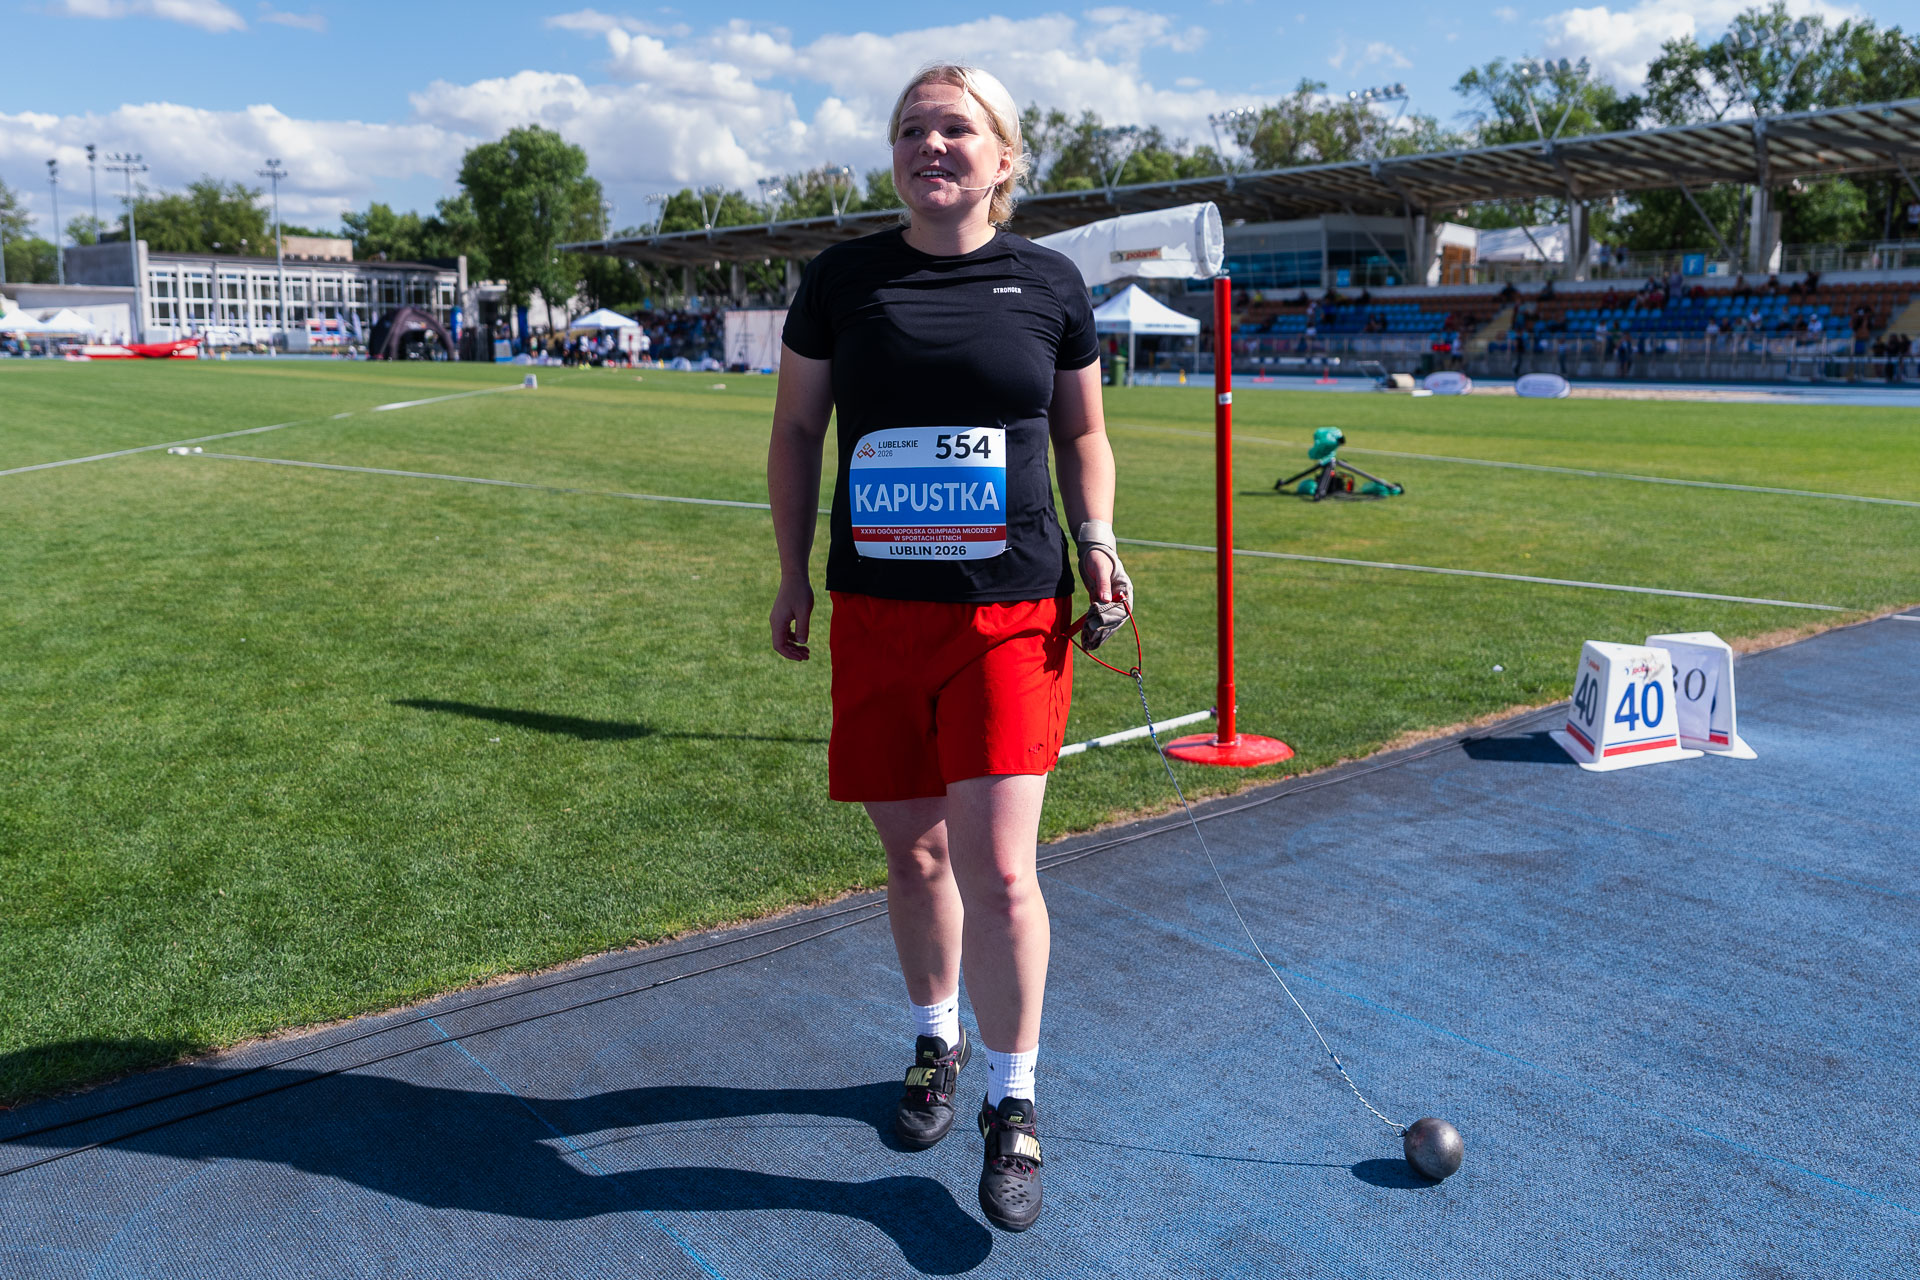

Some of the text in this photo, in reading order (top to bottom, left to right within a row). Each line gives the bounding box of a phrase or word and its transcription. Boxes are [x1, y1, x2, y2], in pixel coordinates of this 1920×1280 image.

[877, 450, 893, 458] 2026
[878, 434, 992, 460] LUBELSKIE 554
[855, 482, 1000, 513] KAPUSTKA
[877, 527, 926, 535] OGÓLNOPOLSKA
[927, 527, 961, 535] OLIMPIADA
[889, 545, 967, 556] LUBLIN 2026
[1574, 672, 1598, 727] 40
[1614, 680, 1664, 731] 40
[905, 1067, 936, 1087] NIKE
